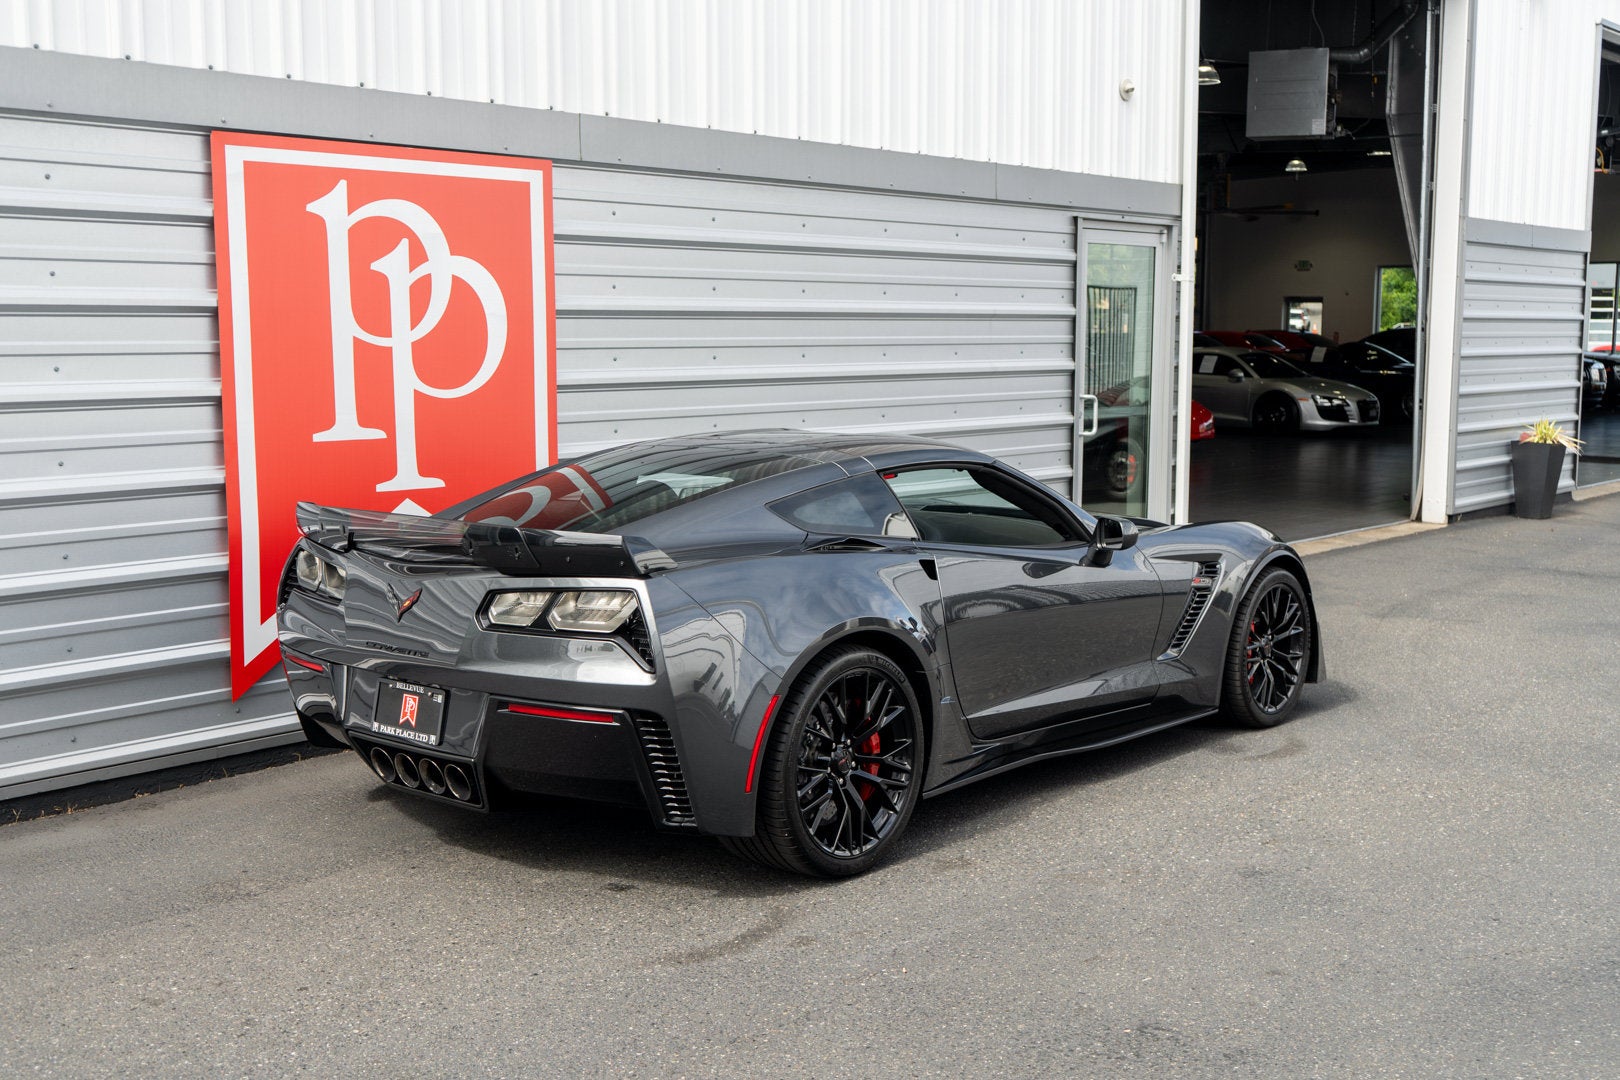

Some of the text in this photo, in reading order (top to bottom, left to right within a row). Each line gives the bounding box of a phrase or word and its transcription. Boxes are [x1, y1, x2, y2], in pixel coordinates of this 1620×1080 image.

[396, 682, 425, 694] BELLEVUE
[380, 724, 428, 743] PARK PLACE LTD
